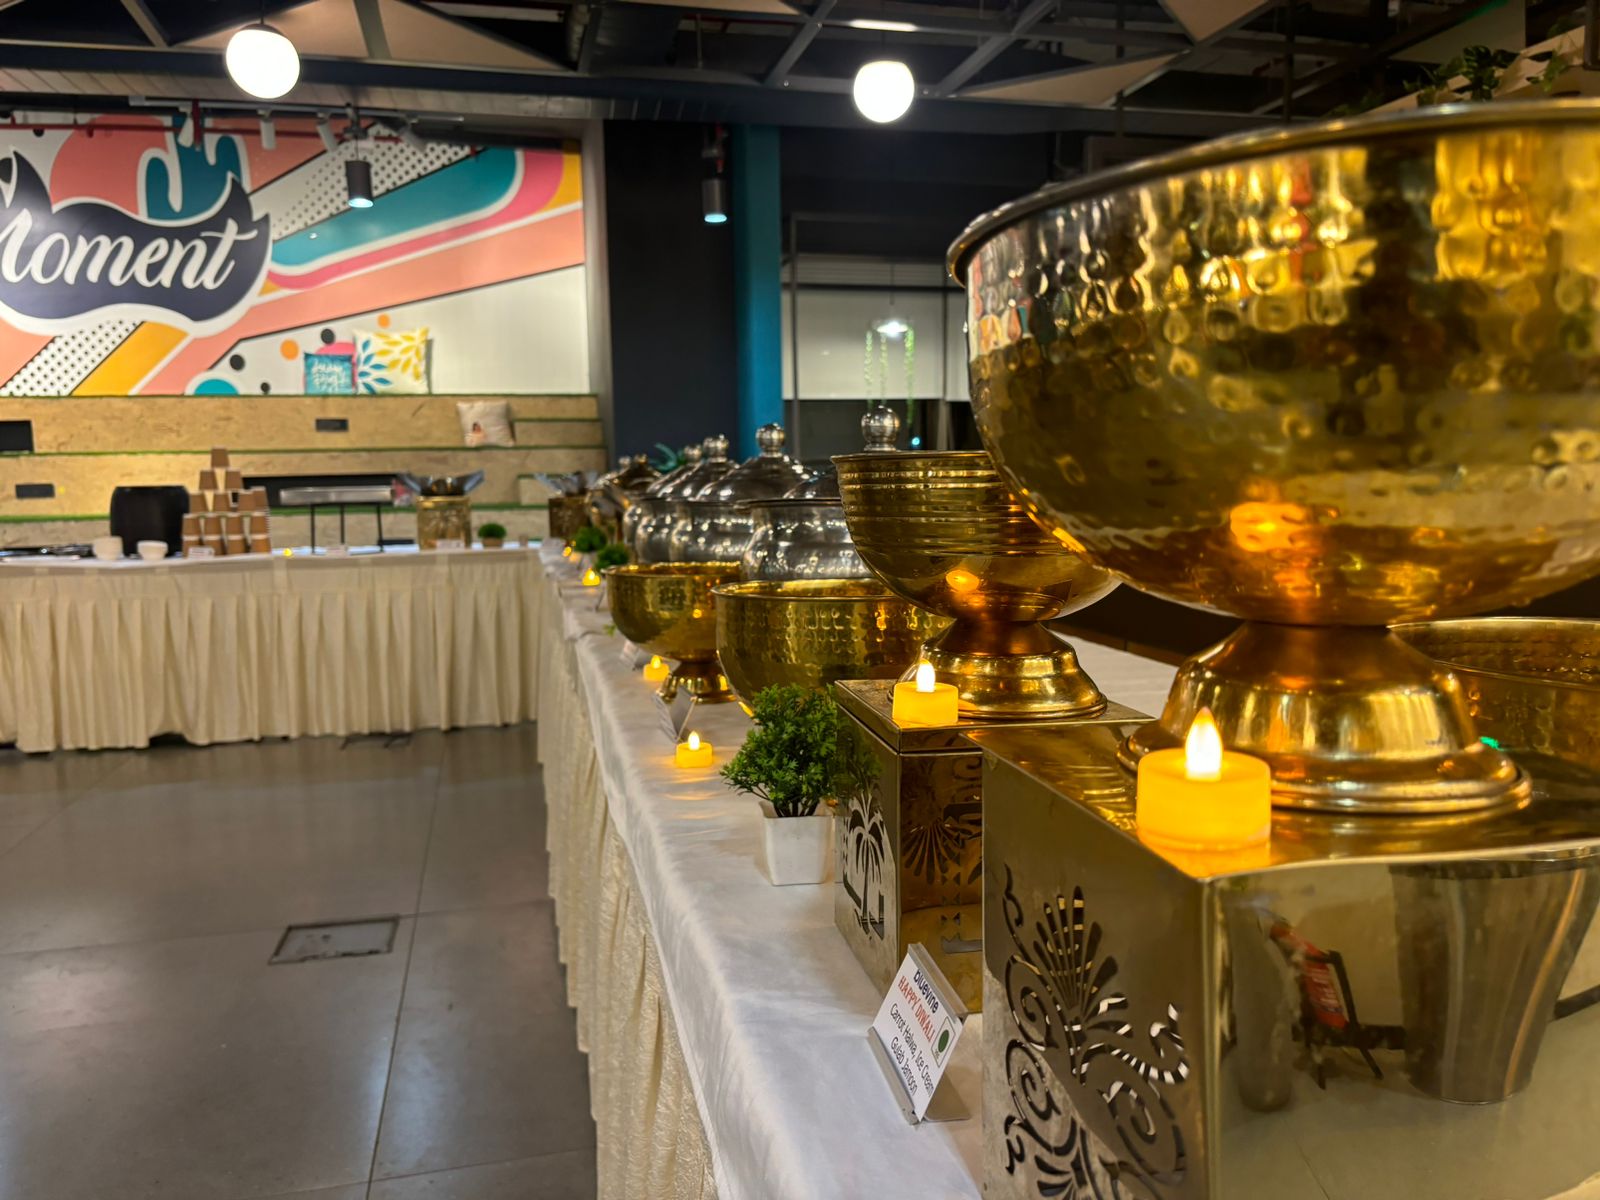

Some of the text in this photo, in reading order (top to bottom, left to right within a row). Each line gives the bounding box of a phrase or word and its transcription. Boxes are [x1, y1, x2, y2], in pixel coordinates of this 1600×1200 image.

[898, 975, 935, 1043] HAPPY DIWALI
[914, 969, 939, 1013] bluevine
[890, 1003, 906, 1032] Carrot
[915, 1050, 924, 1071] Ice
[921, 1064, 934, 1097] Cream
[891, 1036, 905, 1065] Gulab
